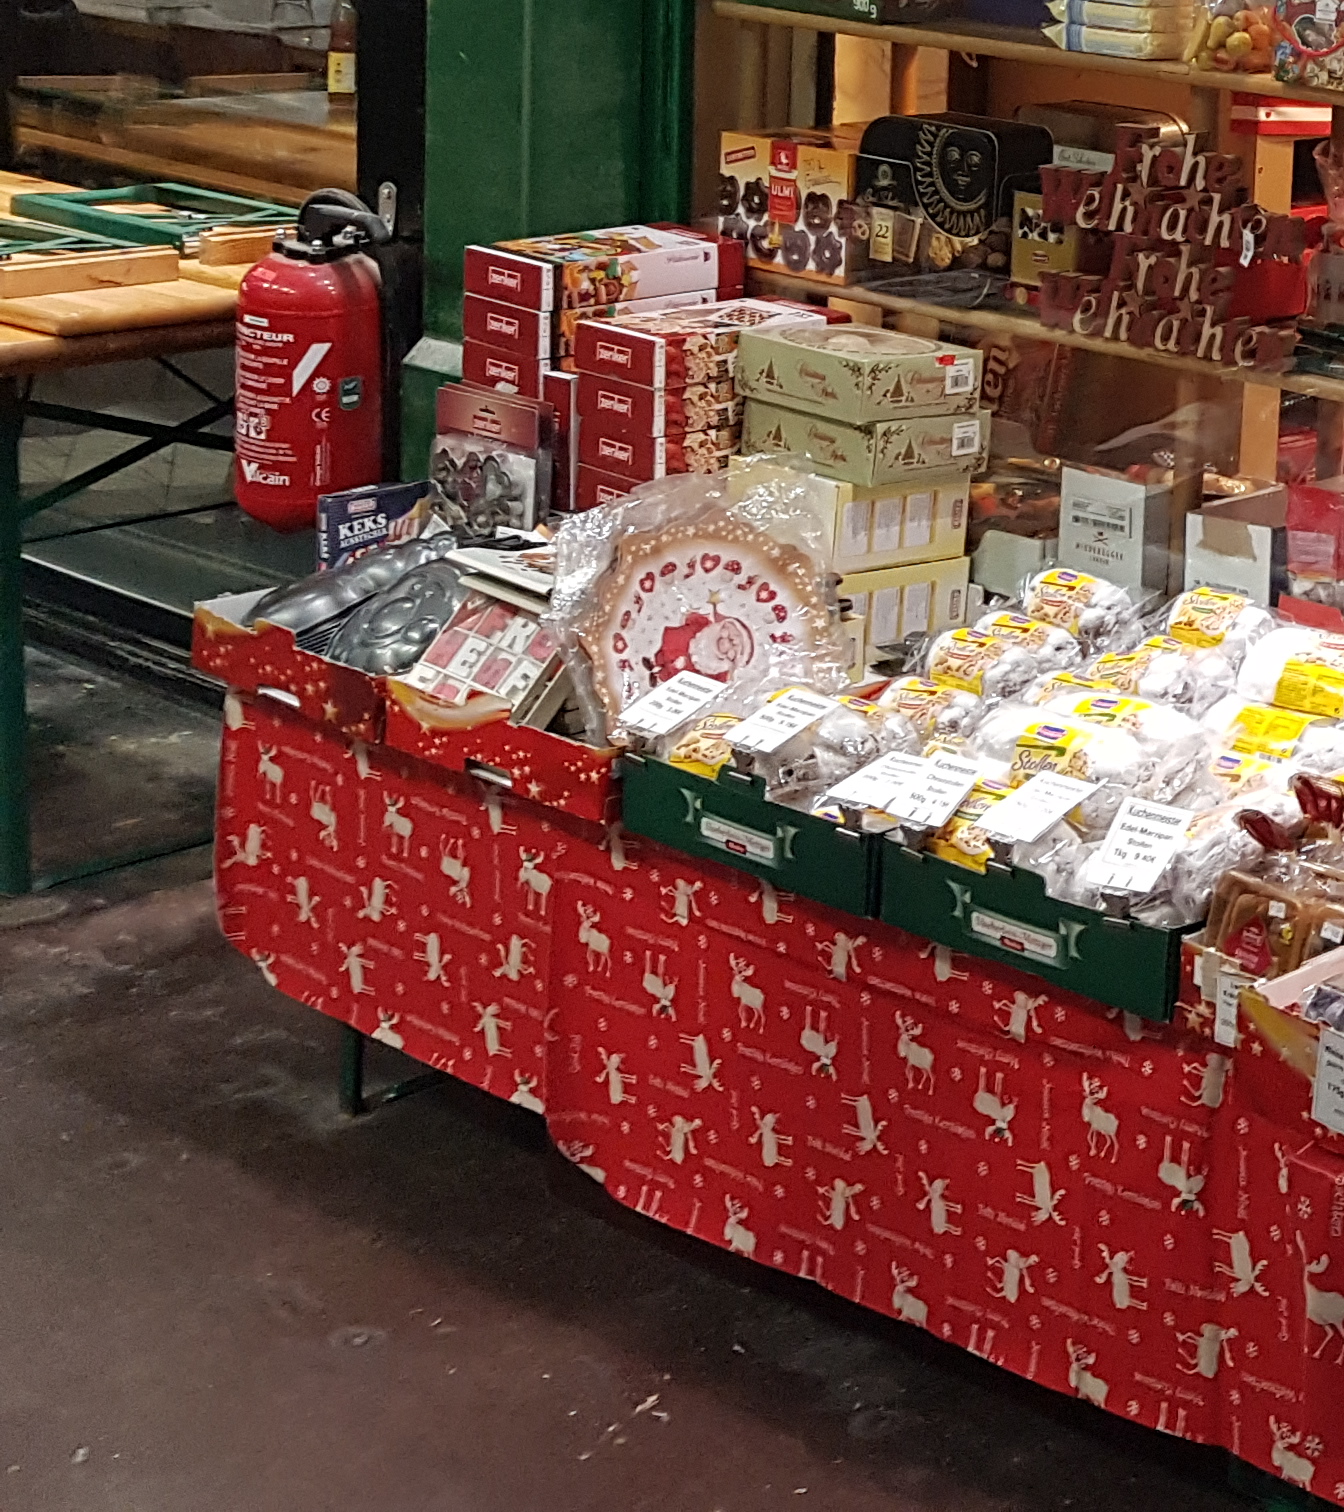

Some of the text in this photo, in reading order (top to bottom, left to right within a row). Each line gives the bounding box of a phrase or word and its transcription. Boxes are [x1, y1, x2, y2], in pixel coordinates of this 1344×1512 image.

[875, 223, 890, 238] 22
[489, 271, 519, 289] zenker
[489, 317, 518, 336] zenker
[598, 347, 630, 365] zenker
[487, 362, 518, 382] zenker
[600, 396, 632, 414] zenker
[600, 442, 633, 462] zenker
[599, 489, 625, 502] zenk
[338, 512, 389, 540] KEKS
[1011, 749, 1058, 774] Stollen
